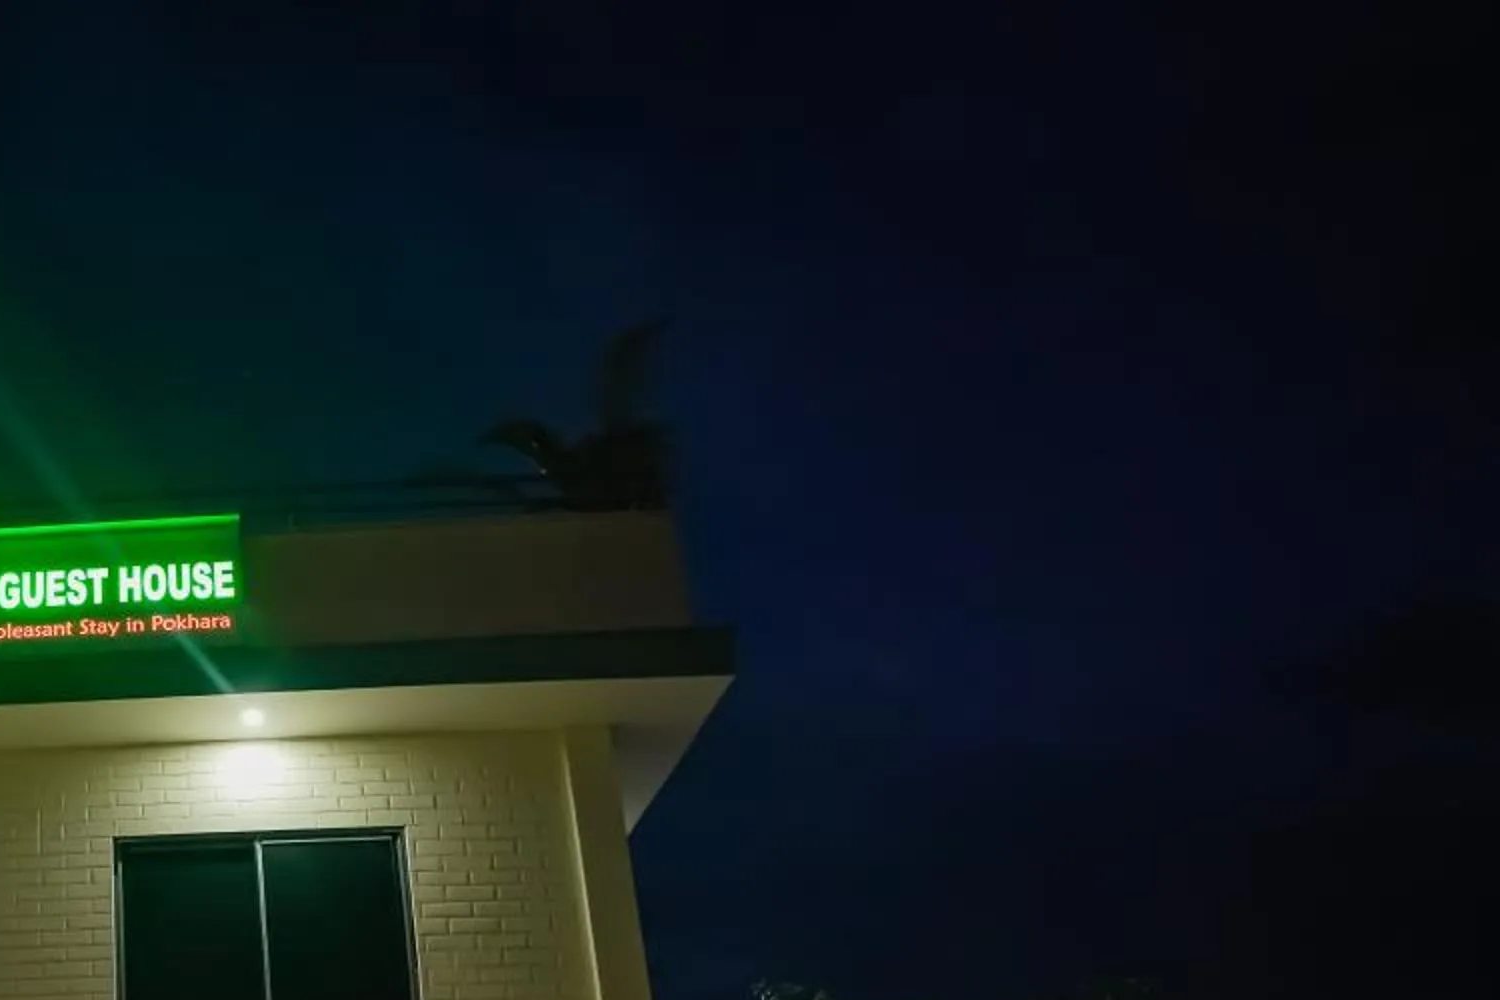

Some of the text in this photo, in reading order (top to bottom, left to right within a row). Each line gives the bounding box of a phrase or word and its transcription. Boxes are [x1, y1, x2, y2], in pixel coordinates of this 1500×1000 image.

[118, 560, 235, 603] HOUSE
[79, 617, 120, 637] Stay
[126, 617, 145, 632] in
[151, 613, 231, 632] Pokhara
